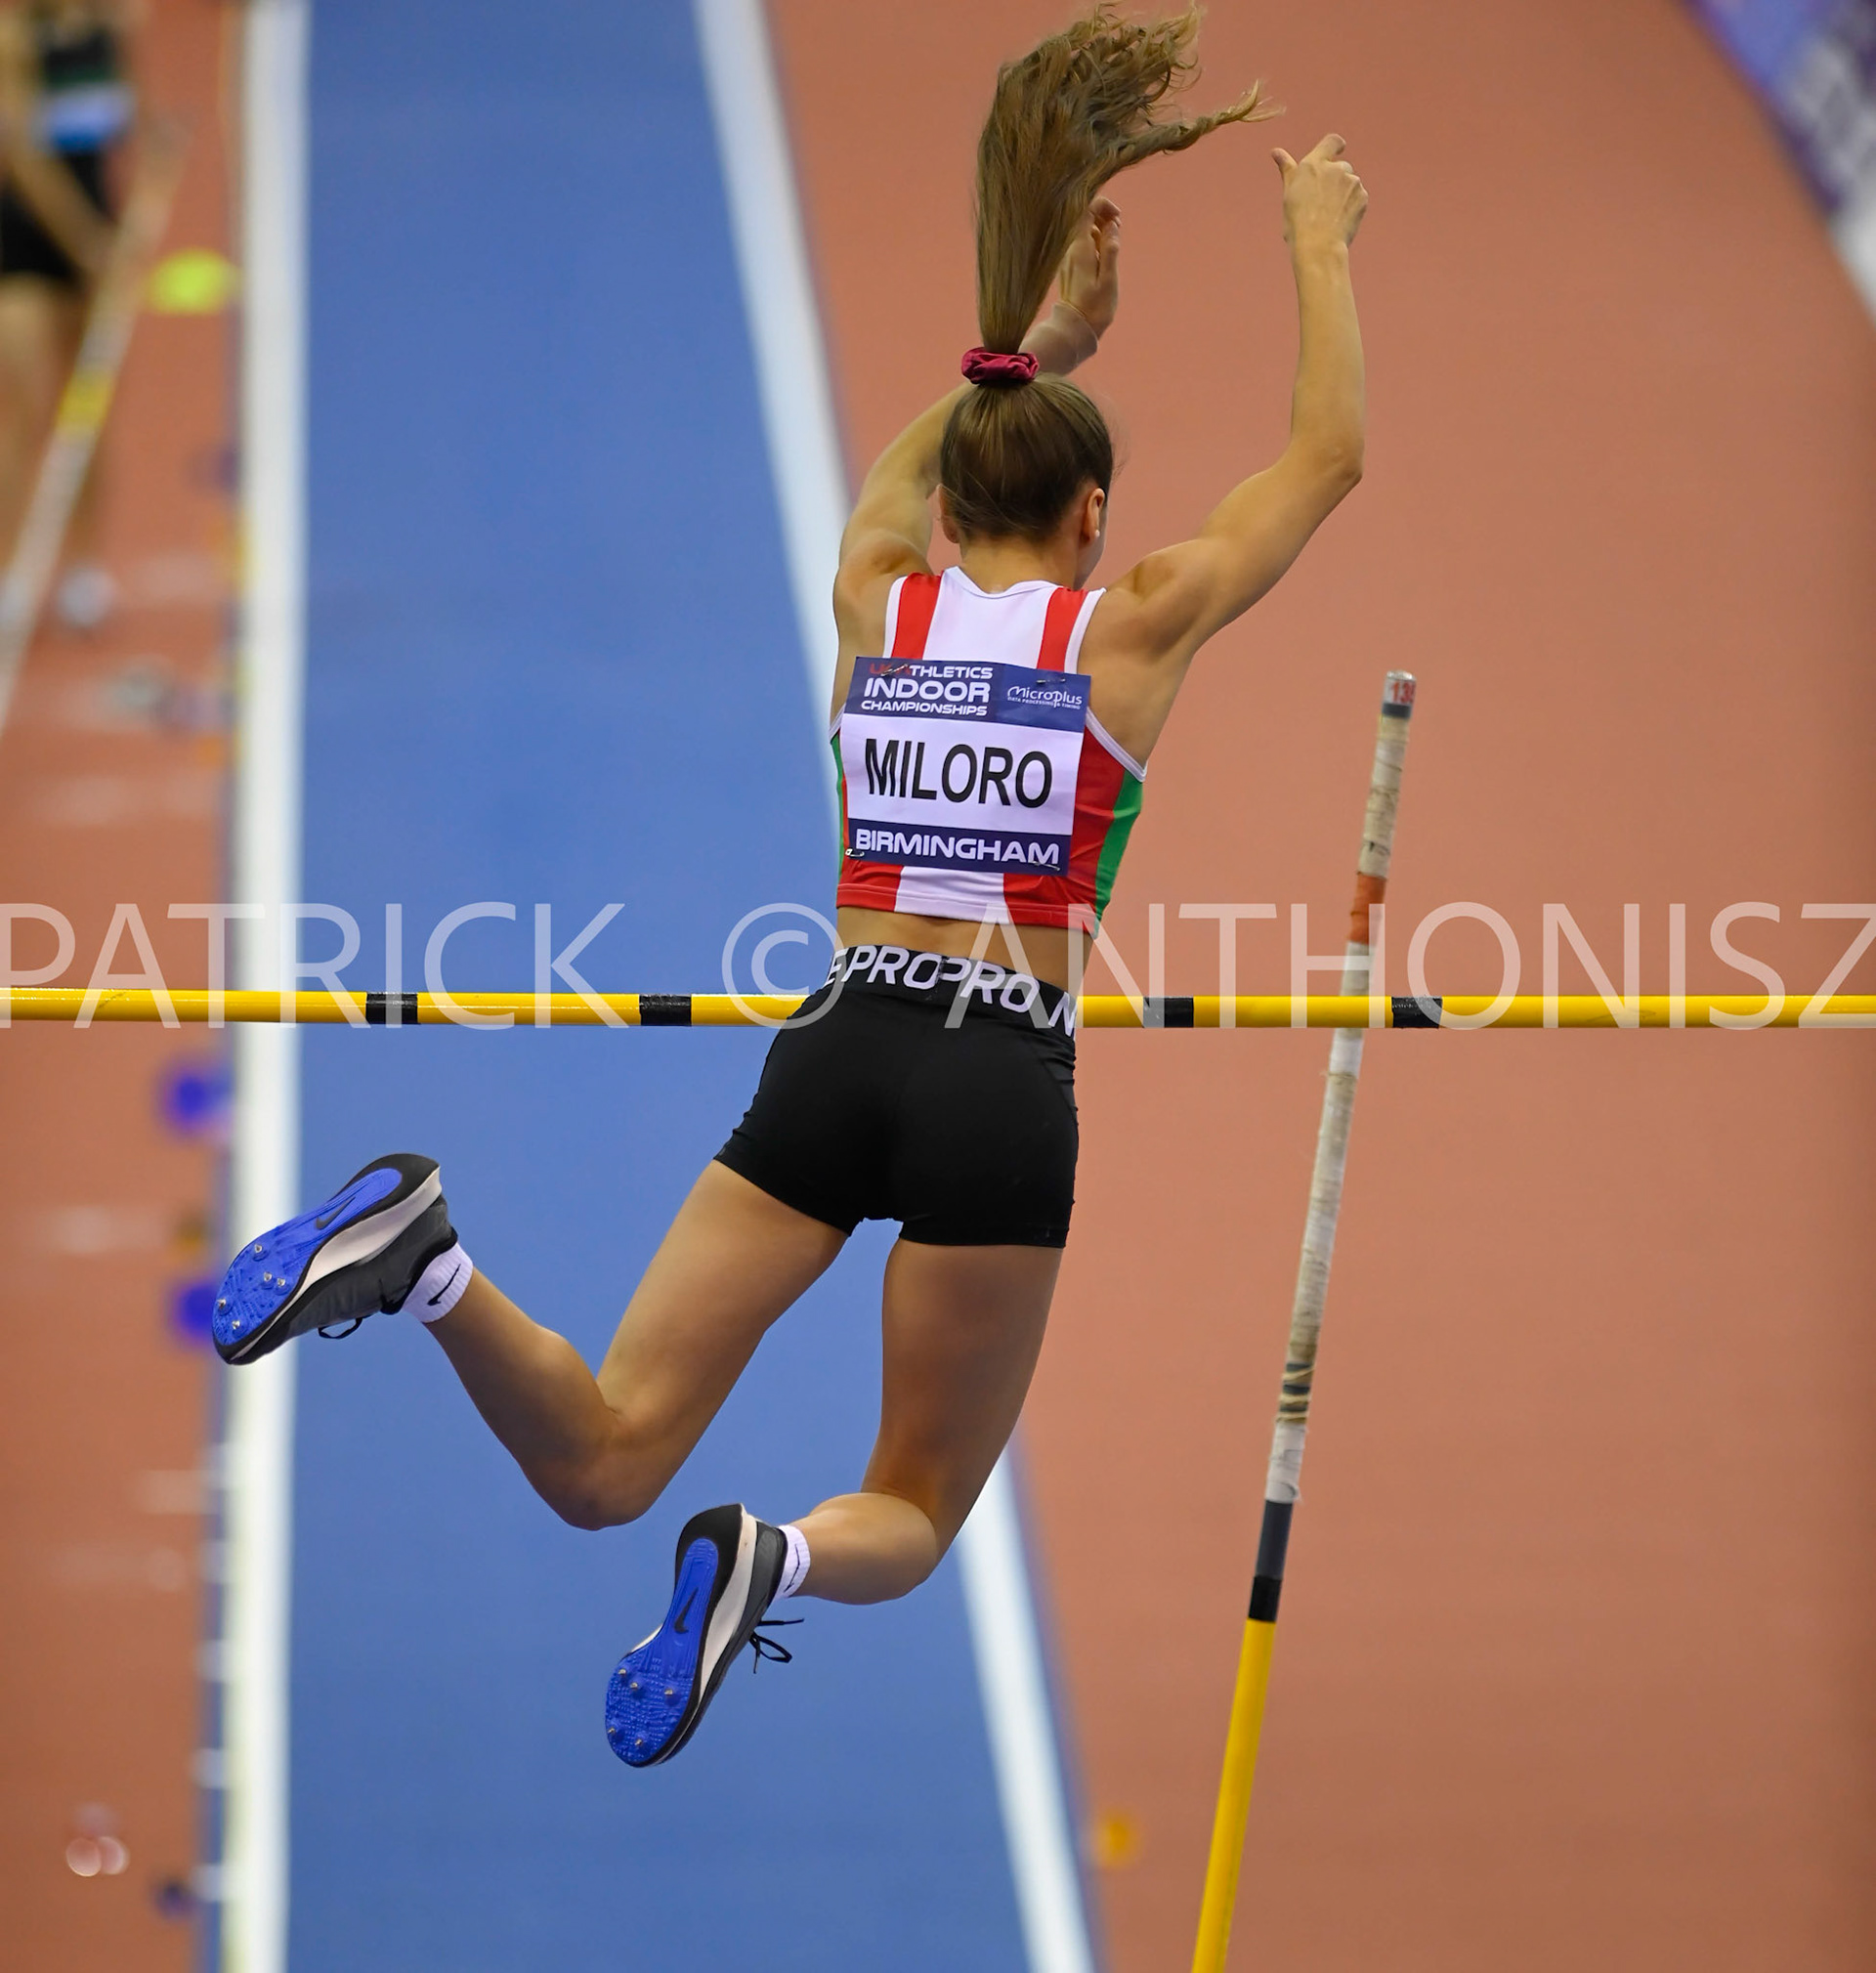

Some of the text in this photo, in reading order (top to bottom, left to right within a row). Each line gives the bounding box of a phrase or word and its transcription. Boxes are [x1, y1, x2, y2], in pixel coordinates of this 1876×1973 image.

[864, 677, 991, 703] INDOOR
[861, 701, 987, 716] CHAMPIONSHIPS
[865, 738, 1052, 808] MILORO
[855, 829, 1059, 865] BIRMINGHAM
